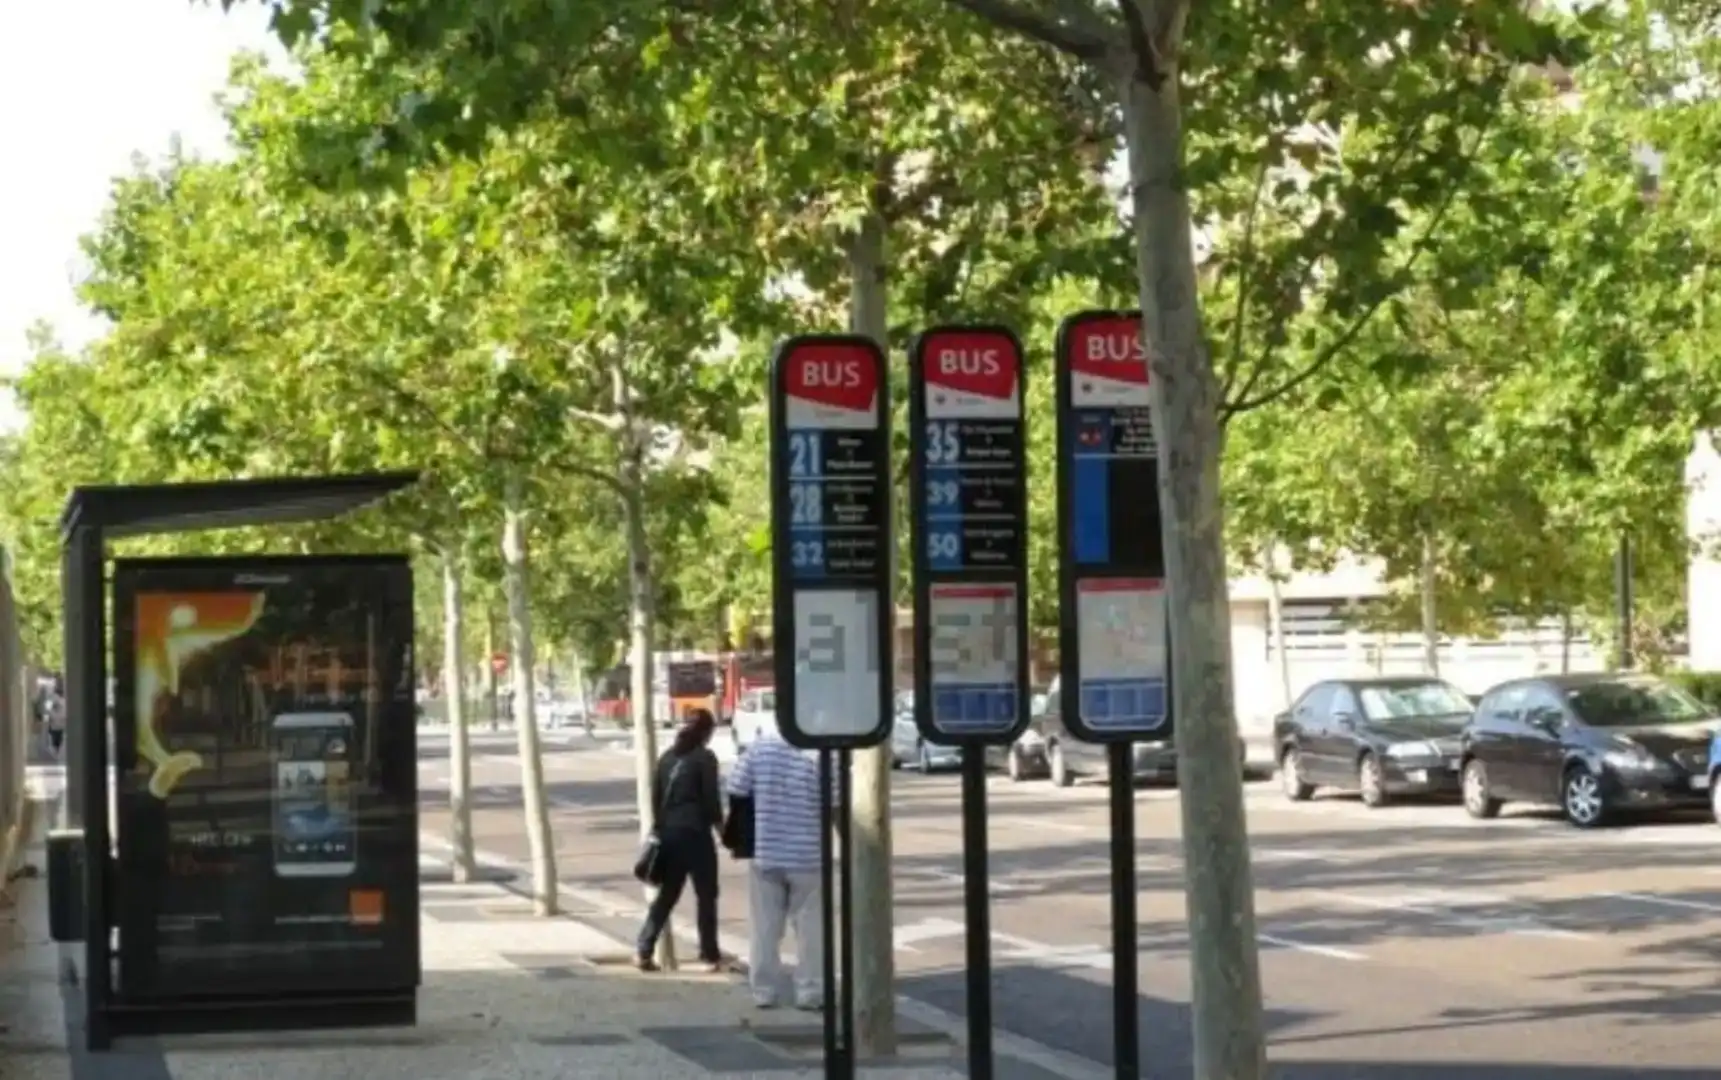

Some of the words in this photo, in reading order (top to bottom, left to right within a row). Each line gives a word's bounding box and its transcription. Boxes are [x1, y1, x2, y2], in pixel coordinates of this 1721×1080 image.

[802, 361, 861, 387] BUS
[939, 349, 1000, 375] BUS
[789, 434, 822, 474] 21
[925, 423, 959, 462] 35
[789, 485, 822, 523] 28
[926, 482, 959, 504] 39
[791, 541, 823, 567] 32
[927, 533, 959, 558] 50
